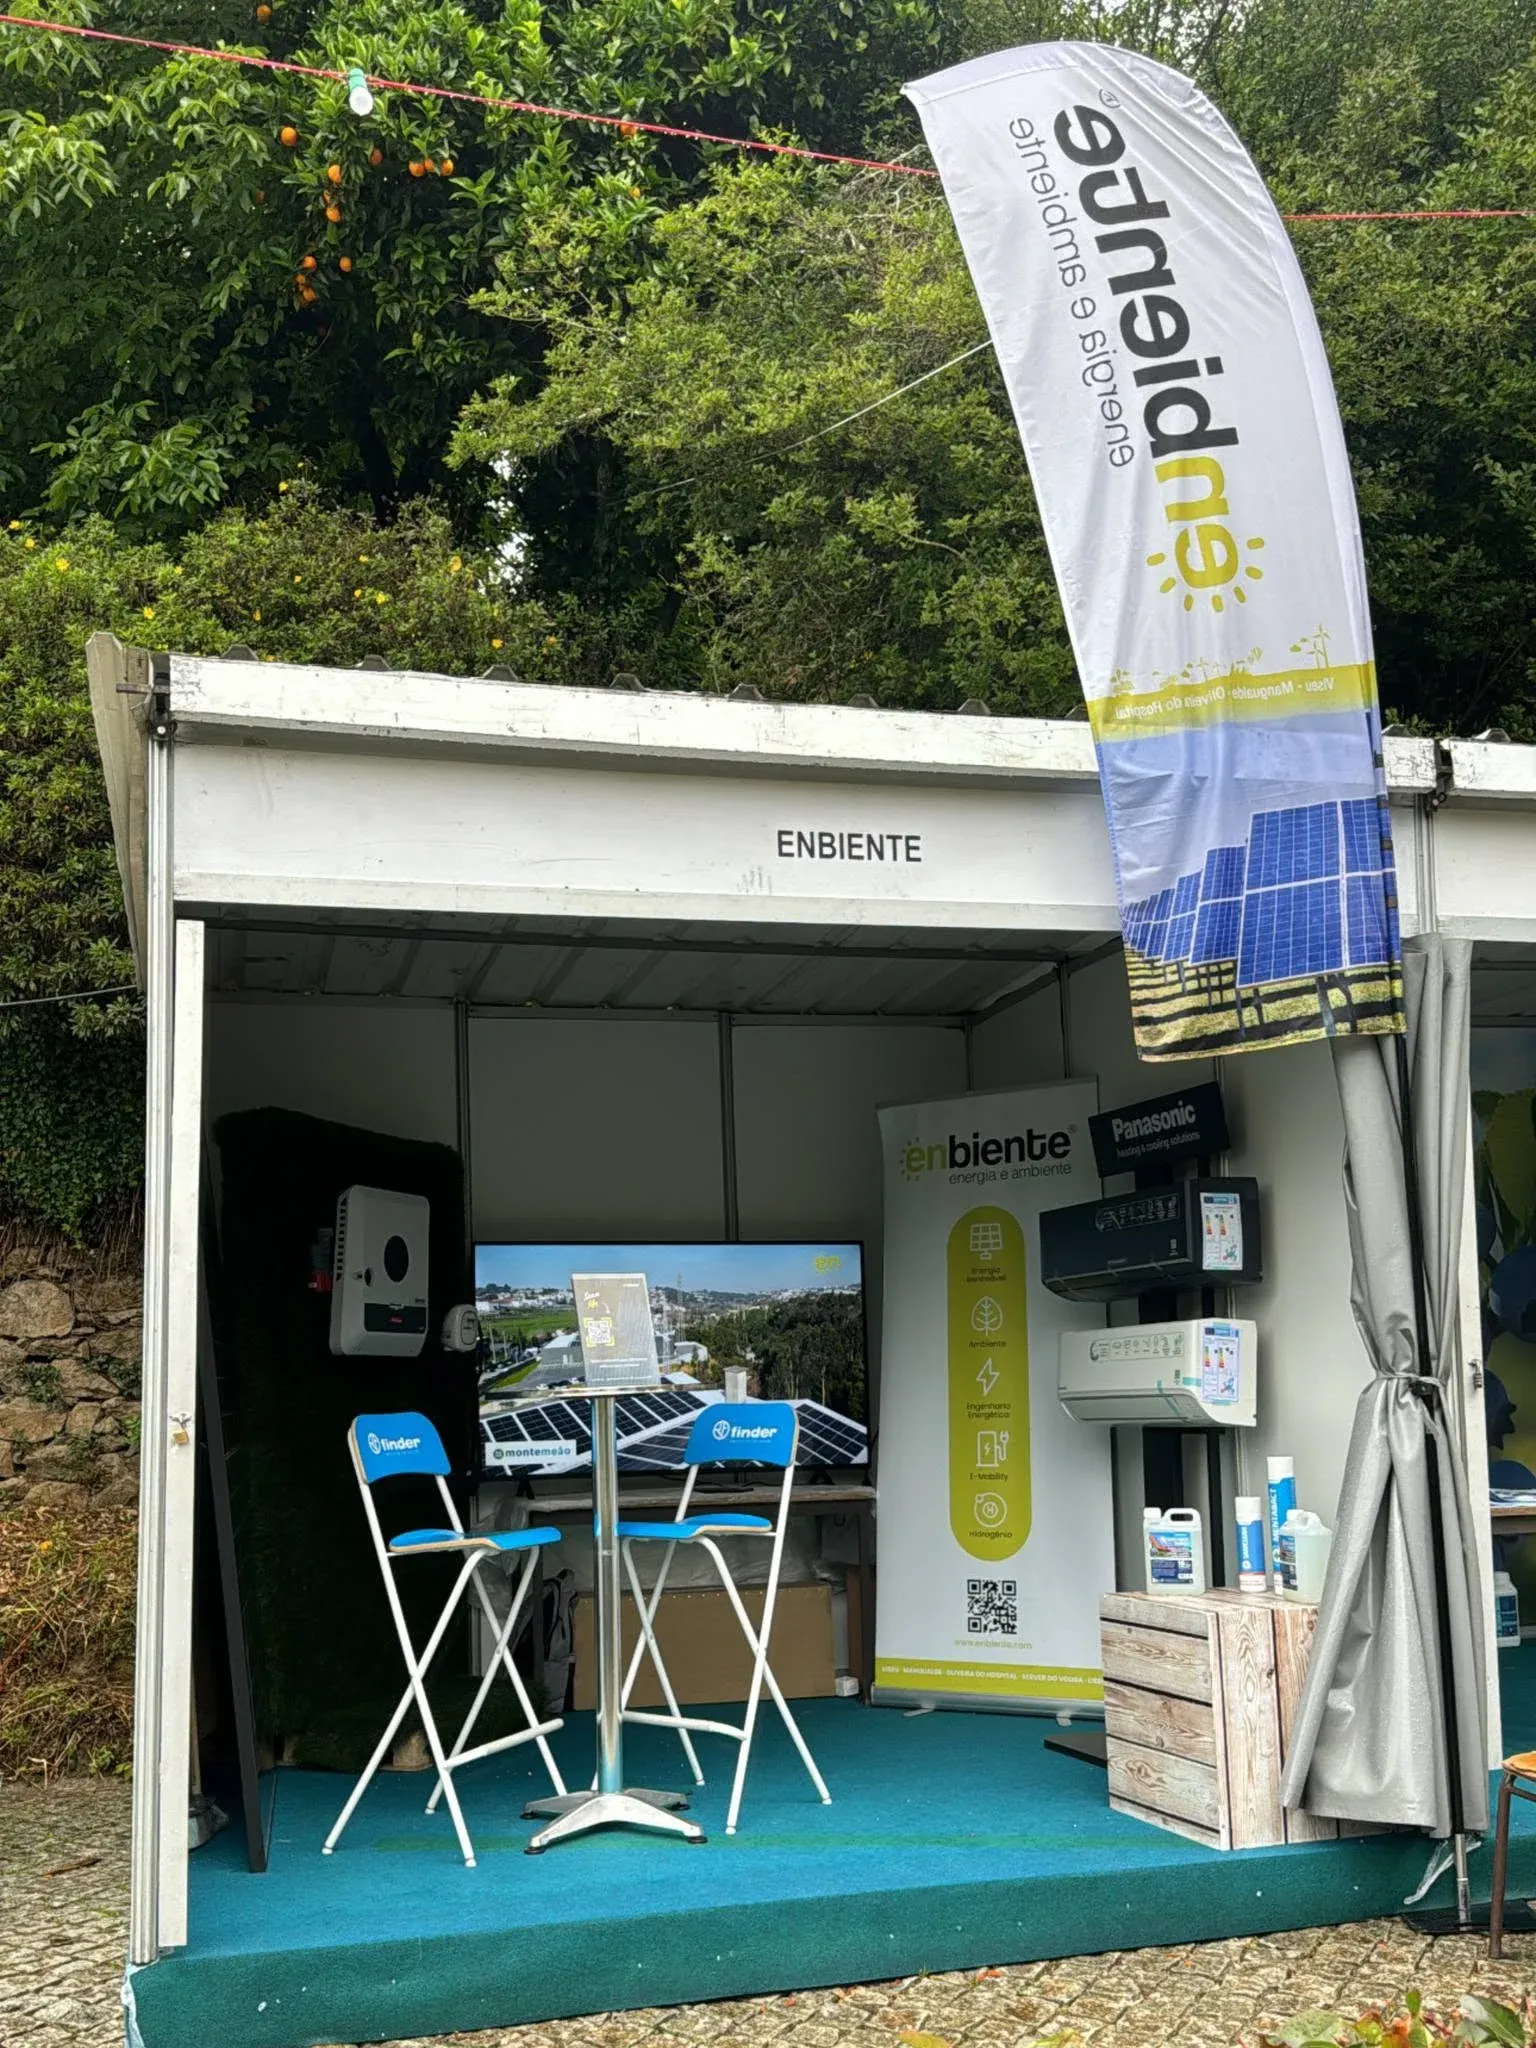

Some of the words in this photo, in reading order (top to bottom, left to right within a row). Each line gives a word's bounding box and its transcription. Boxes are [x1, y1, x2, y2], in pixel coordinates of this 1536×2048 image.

[777, 830, 922, 862] ENBIENTE
[1112, 1100, 1197, 1143] Panasonic
[905, 1127, 1072, 1173] enbiente
[949, 1168, 997, 1185] energia
[1000, 1171, 1009, 1181] e
[1011, 1163, 1072, 1180] ambiente
[380, 1436, 421, 1451] finder
[731, 1426, 778, 1439] finder
